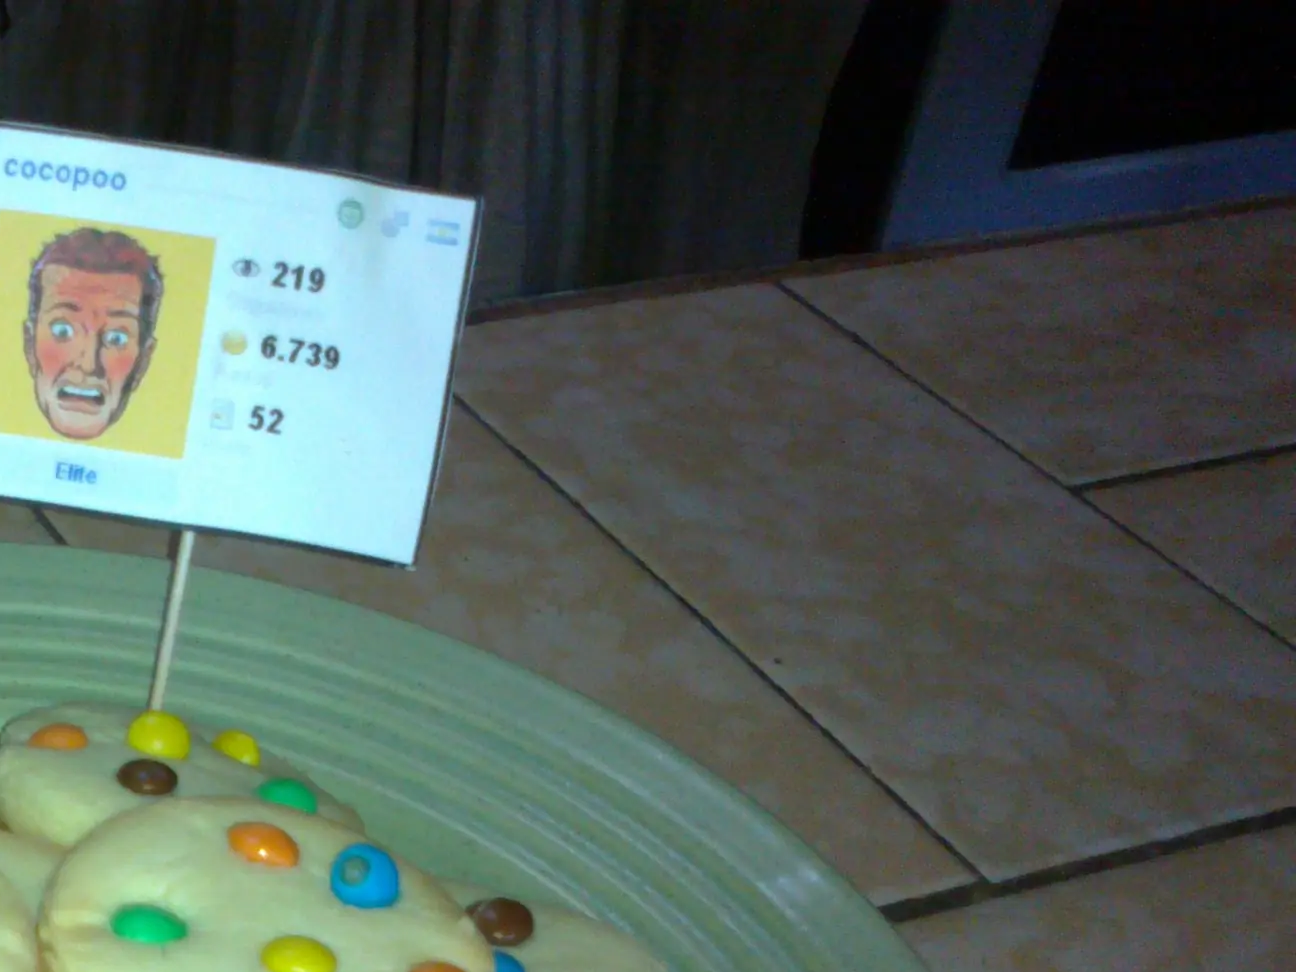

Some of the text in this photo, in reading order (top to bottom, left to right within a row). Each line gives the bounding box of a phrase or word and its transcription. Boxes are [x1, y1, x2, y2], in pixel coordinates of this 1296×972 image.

[4, 158, 127, 192] cocopoo
[271, 261, 326, 293] 219
[260, 334, 340, 370] 6.739
[248, 404, 285, 435] 52
